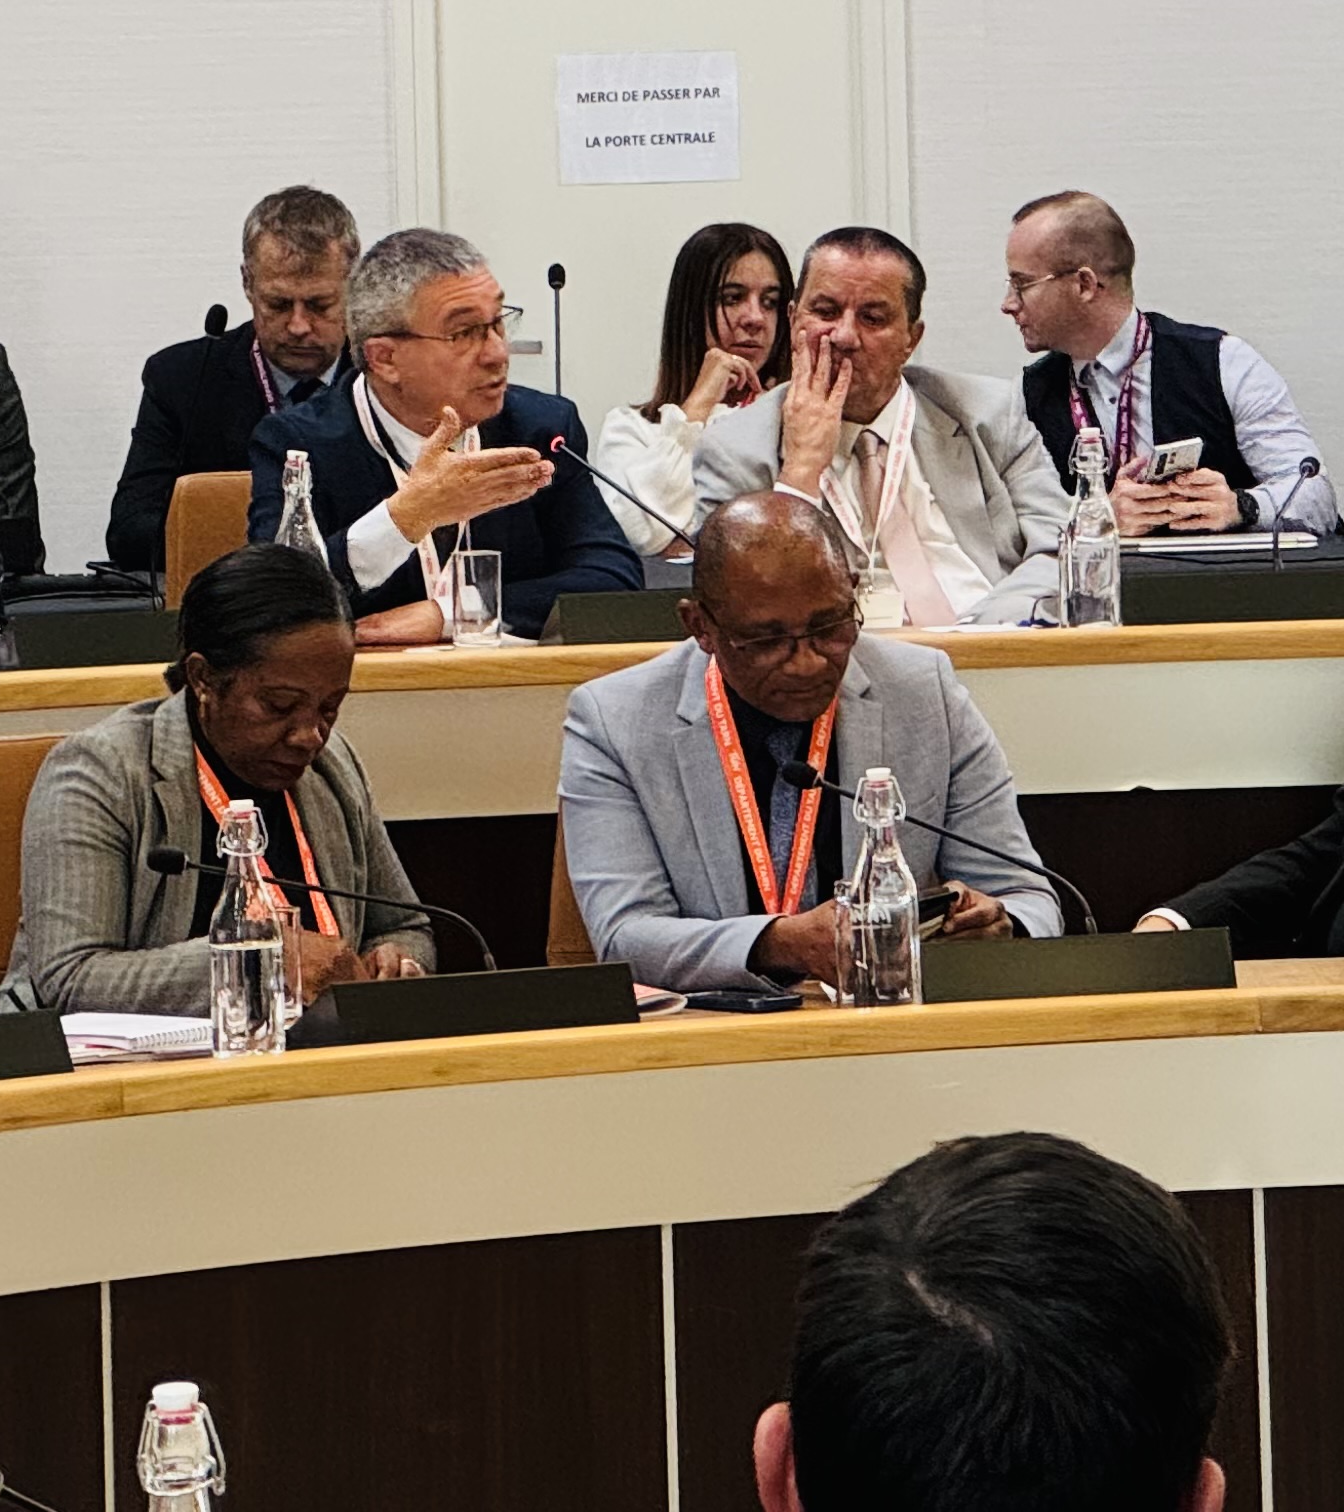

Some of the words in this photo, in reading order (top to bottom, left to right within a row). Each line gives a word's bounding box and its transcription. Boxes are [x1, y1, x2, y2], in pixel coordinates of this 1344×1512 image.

[576, 91, 619, 104] MERCI
[622, 90, 638, 102] DE
[642, 88, 691, 101] PASSER
[694, 87, 721, 99] PAR
[585, 137, 602, 148] LA
[604, 135, 646, 147] PORTE
[649, 131, 716, 145] CENTRALE
[733, 775, 761, 849] DÉPARTEMENT
[754, 848, 766, 863] DU
